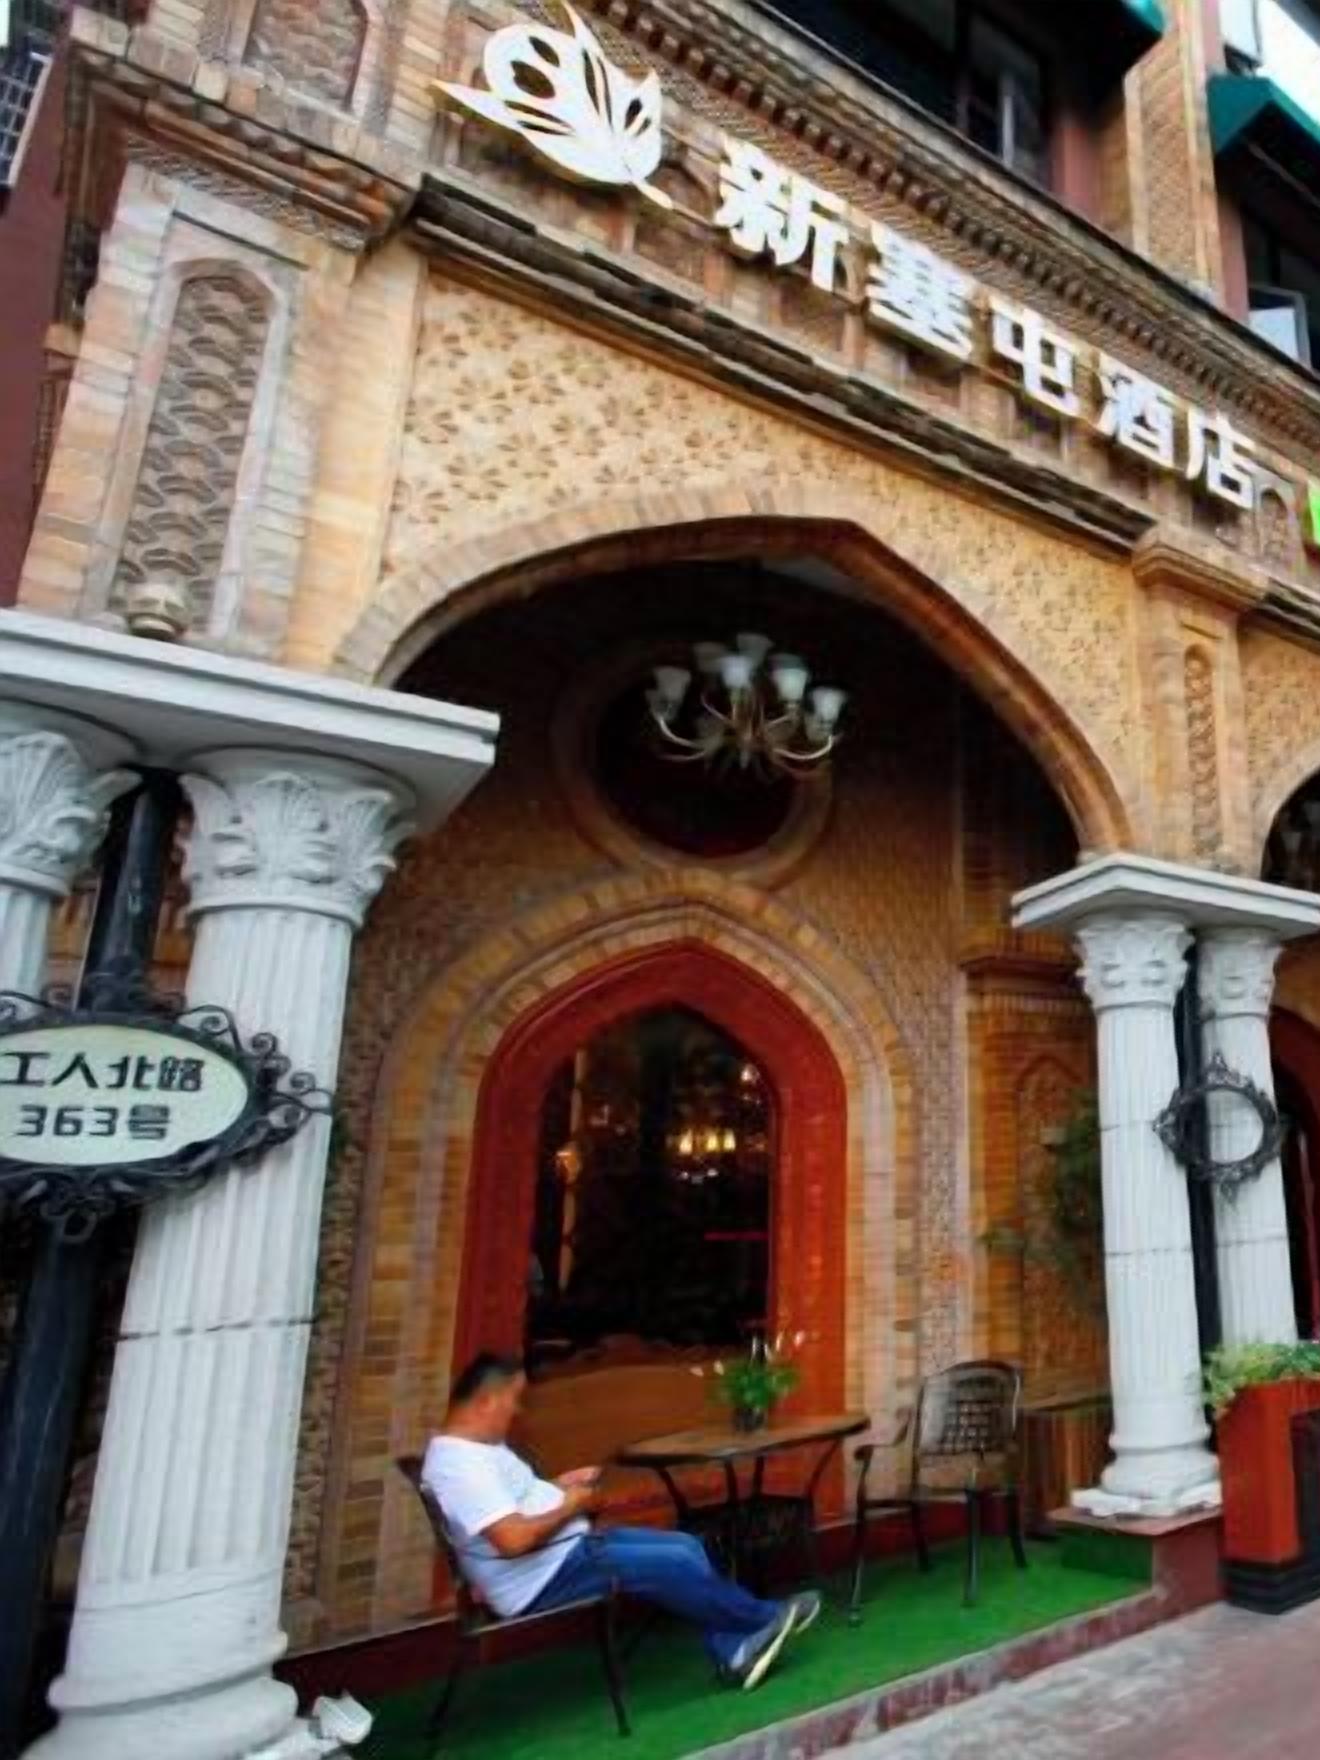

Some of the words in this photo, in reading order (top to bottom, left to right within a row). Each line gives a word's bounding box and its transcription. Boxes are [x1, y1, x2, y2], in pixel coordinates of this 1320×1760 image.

[714, 134, 1260, 510] 新塞屯酒店
[0, 1052, 205, 1093] 工人北路
[15, 1104, 171, 1140] 363号
